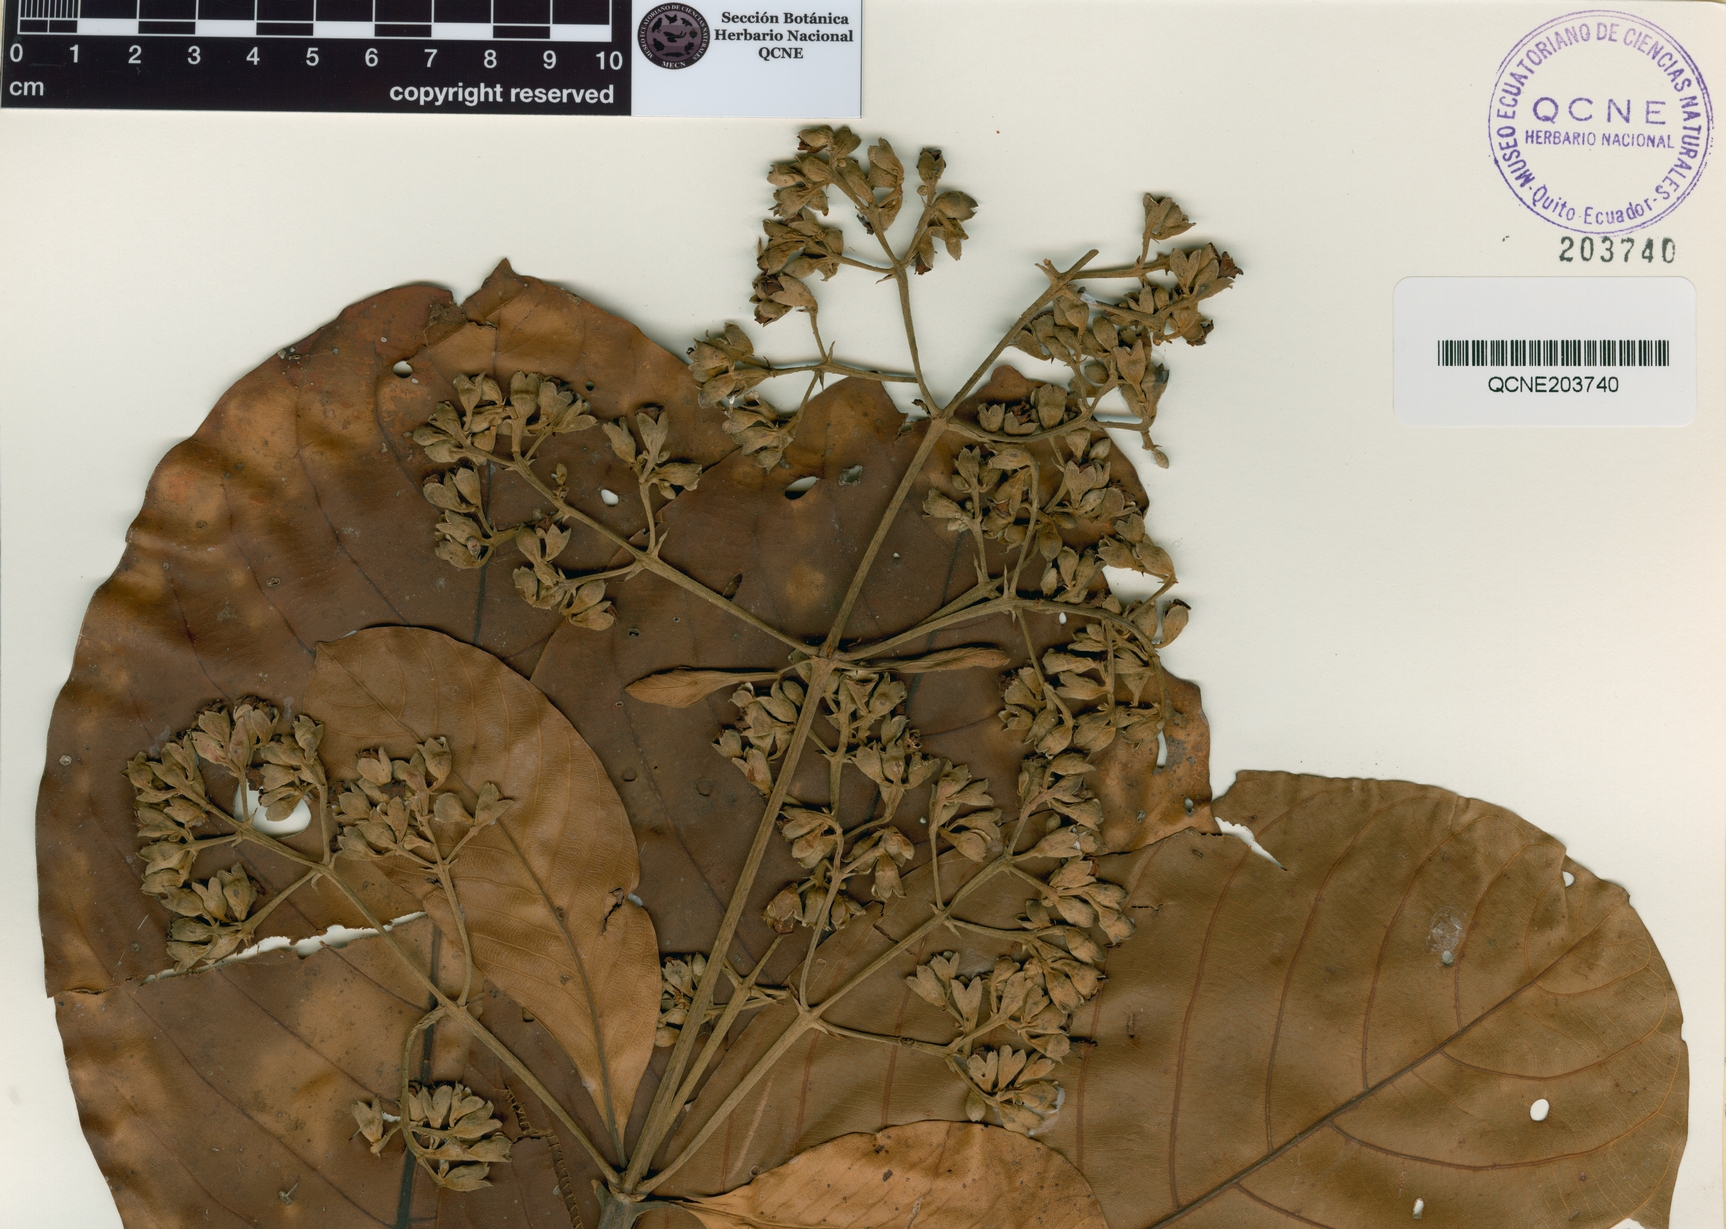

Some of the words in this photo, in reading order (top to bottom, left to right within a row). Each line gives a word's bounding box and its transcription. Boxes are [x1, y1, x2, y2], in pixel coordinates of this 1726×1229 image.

[721, 11, 779, 24] Sección
[783, 12, 849, 25] Botánica
[714, 28, 783, 41] Herbario
[787, 29, 854, 42] Nacional
[1596, 22, 1620, 43] DE
[9, 43, 24, 63] 0
[69, 44, 79, 63] 1
[128, 45, 142, 64] 2
[187, 46, 201, 65] 3
[246, 46, 260, 66] 4
[305, 47, 320, 67] 5
[364, 47, 379, 67] 6
[424, 48, 438, 68] 7
[483, 49, 498, 69] 8
[542, 50, 557, 70] 9
[596, 50, 623, 71] 10
[661, 61, 686, 69] MECN
[758, 47, 803, 61] QCNE
[1623, 27, 1692, 92] CIENCIAS
[1496, 23, 1591, 120] ECUATORIANO
[9, 80, 45, 96] cm
[389, 82, 503, 106] copyright
[510, 84, 614, 104] reserved
[1532, 96, 1667, 124] QCNE
[1525, 129, 1596, 146] HERBARIO
[1601, 132, 1675, 149] NACIONAL
[1655, 95, 1702, 200] NATURALES
[1496, 125, 1536, 188] MUSEO
[1559, 235, 1675, 264] 203740
[1488, 376, 1619, 393] QCNE203740
